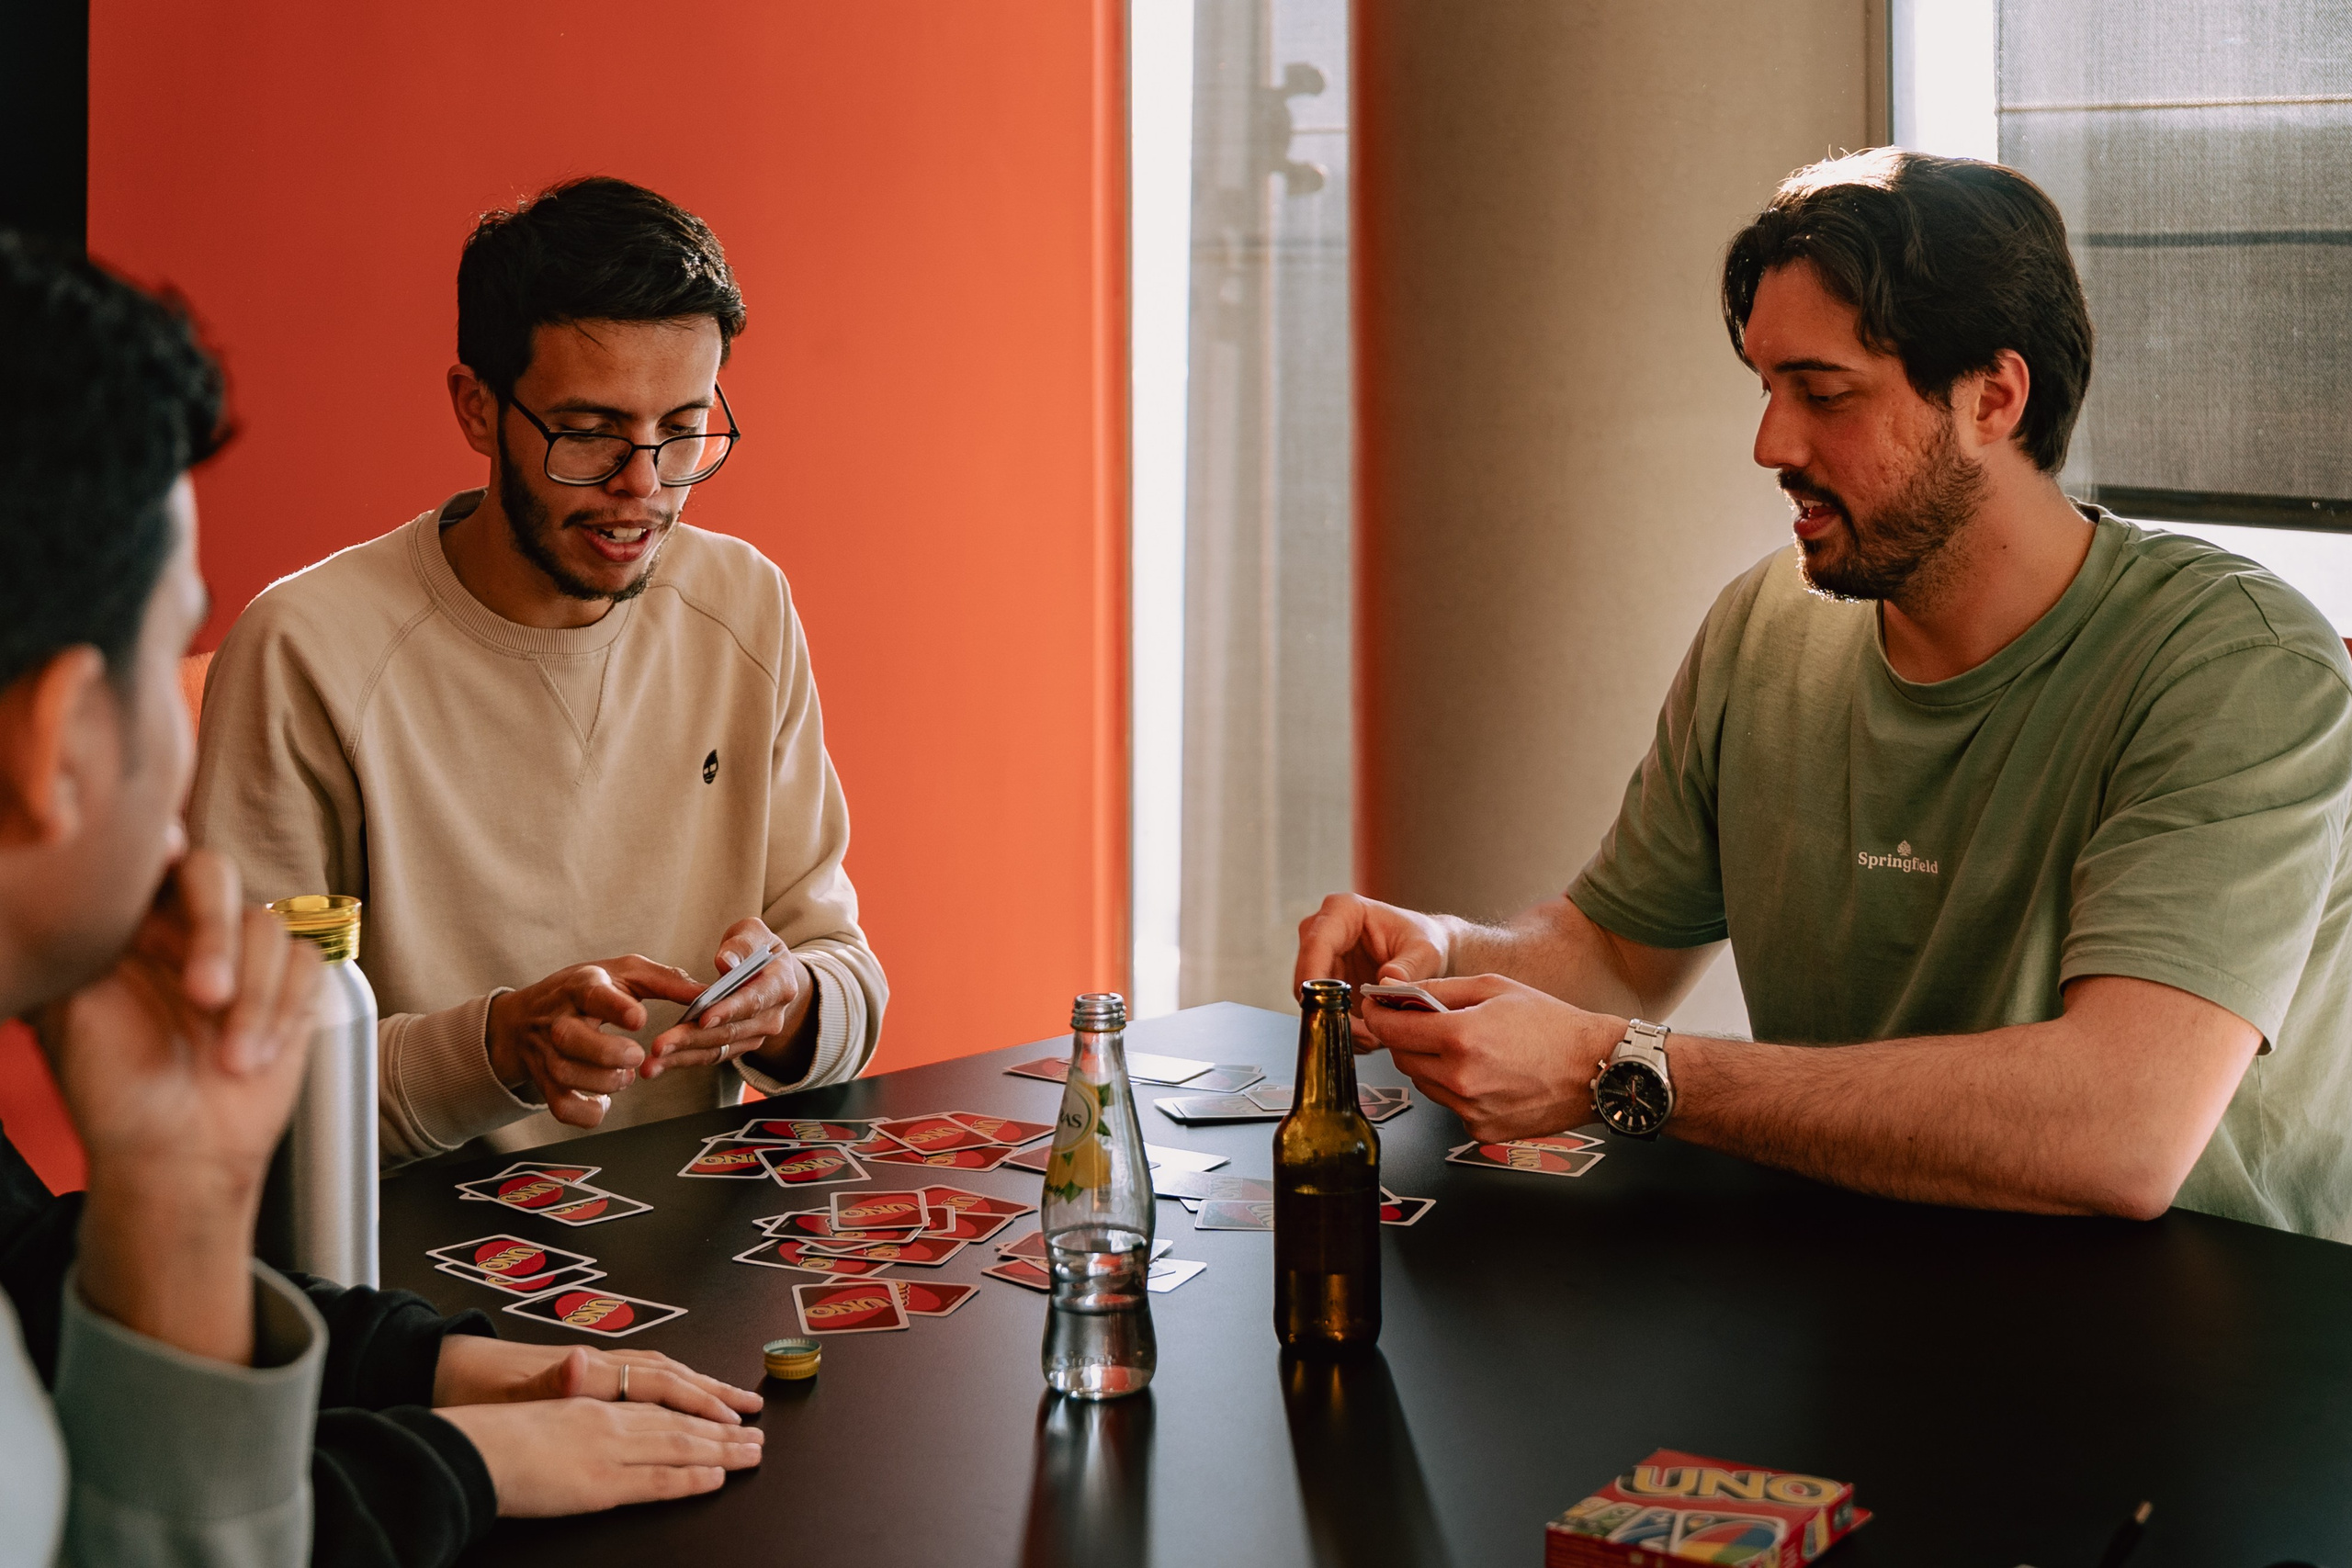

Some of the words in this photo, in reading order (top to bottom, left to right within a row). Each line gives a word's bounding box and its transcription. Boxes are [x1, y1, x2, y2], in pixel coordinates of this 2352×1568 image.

[1858, 852, 1939, 874] Springfield
[901, 1125, 968, 1144] UNO
[774, 1156, 848, 1175] UNO
[1506, 1148, 1542, 1169] UNO
[497, 1180, 568, 1203] UNO
[837, 1201, 921, 1219] UNO
[477, 1246, 545, 1272] UNO
[562, 1296, 628, 1326] UNO
[805, 1296, 894, 1319] UNO
[1619, 1465, 1844, 1506] UNO
